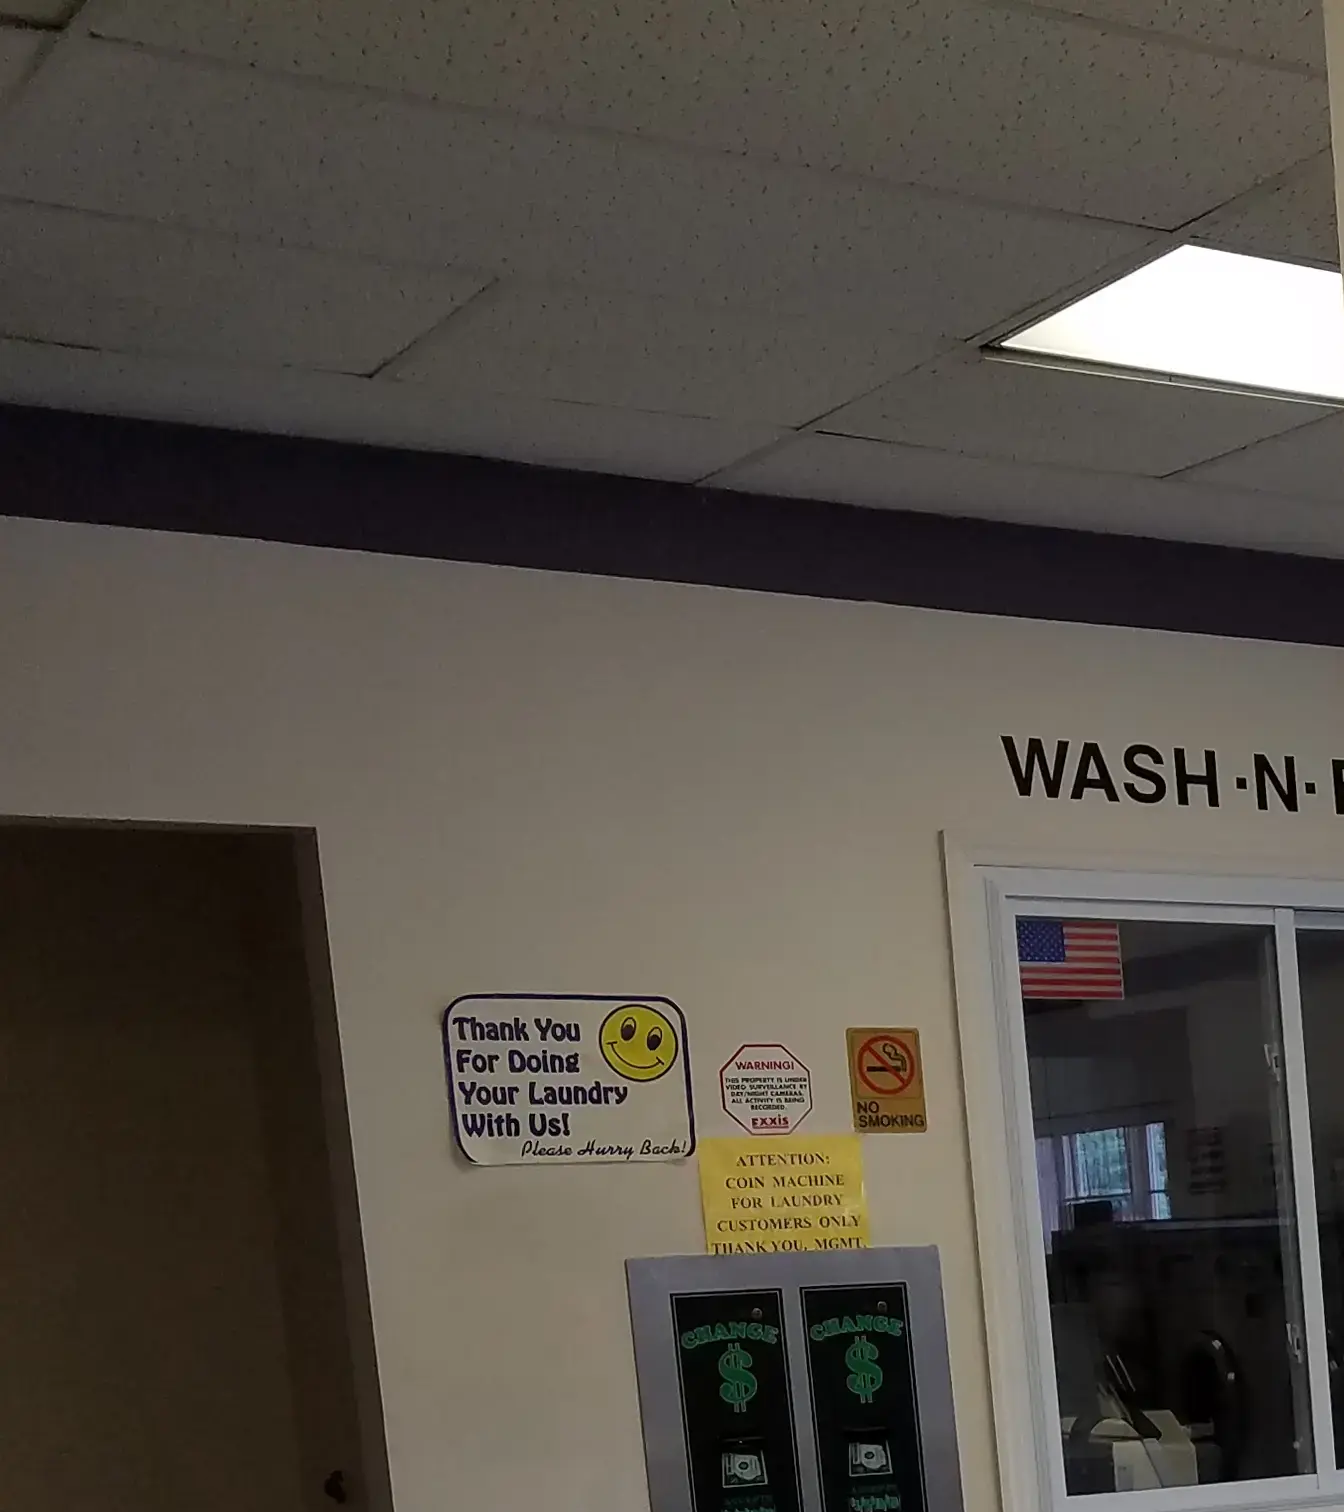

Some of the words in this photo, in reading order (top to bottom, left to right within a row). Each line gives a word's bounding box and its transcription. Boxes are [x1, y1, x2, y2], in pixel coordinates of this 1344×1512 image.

[452, 1016, 530, 1042] Thank
[534, 1018, 581, 1042] You
[455, 1049, 500, 1073] For
[508, 1049, 580, 1074] Doing
[735, 1060, 795, 1070] WARNING!
[458, 1081, 520, 1106] Your
[528, 1081, 628, 1106] Laundry
[857, 1101, 880, 1114] NO
[462, 1112, 521, 1137] With
[528, 1112, 571, 1137] Us!
[858, 1114, 925, 1128] SMOKING
[521, 1140, 573, 1158] Please
[577, 1141, 635, 1160] Hurry
[639, 1138, 688, 1155] Back!
[736, 1153, 830, 1167] ATTENTION:
[725, 1176, 765, 1189] COIN
[773, 1174, 845, 1188] MACHINE
[732, 1197, 763, 1209] FOR
[770, 1194, 843, 1208] LAUNDRY
[717, 1217, 812, 1232] CUSTOMERS
[819, 1215, 862, 1228] ONLY
[712, 1241, 770, 1256] THANK
[681, 1321, 779, 1349] CHANGE
[810, 1315, 904, 1341] CHANGE
